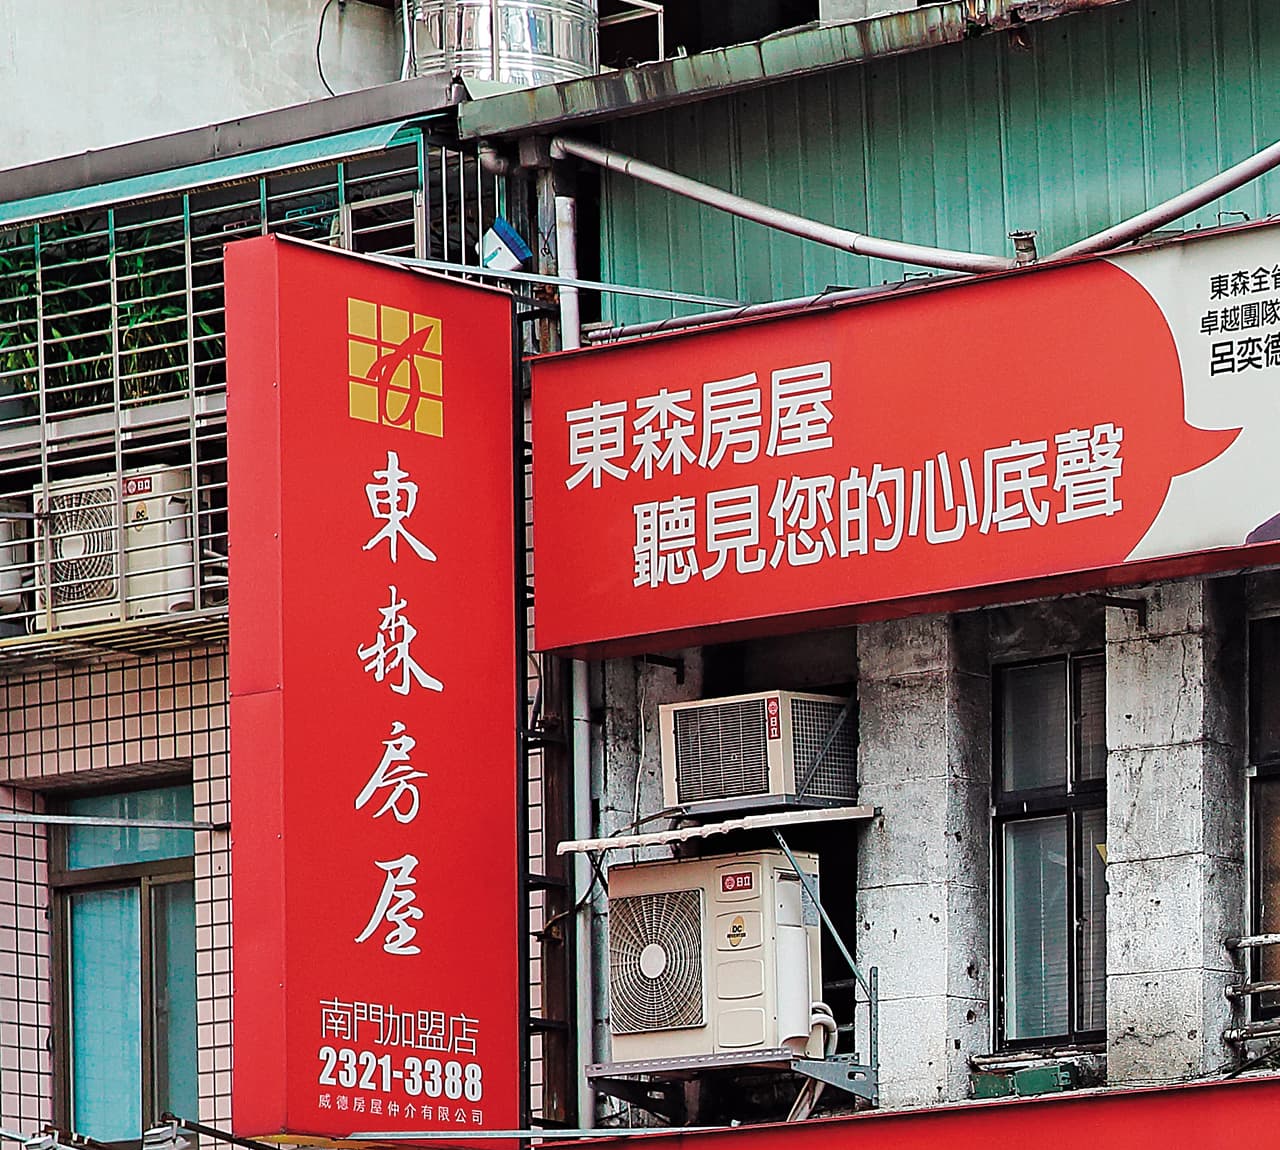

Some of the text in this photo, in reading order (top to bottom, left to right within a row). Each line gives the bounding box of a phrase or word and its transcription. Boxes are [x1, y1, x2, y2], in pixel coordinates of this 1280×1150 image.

[565, 360, 833, 490] 東森房屋
[632, 422, 1125, 588] 聽見您的心底聲
[355, 450, 444, 955] 東森房屋
[319, 997, 479, 1056] 南門加盟店
[319, 1046, 482, 1101] 2321-3388
[318, 1094, 483, 1125] 威德房屋仲介有限公司
